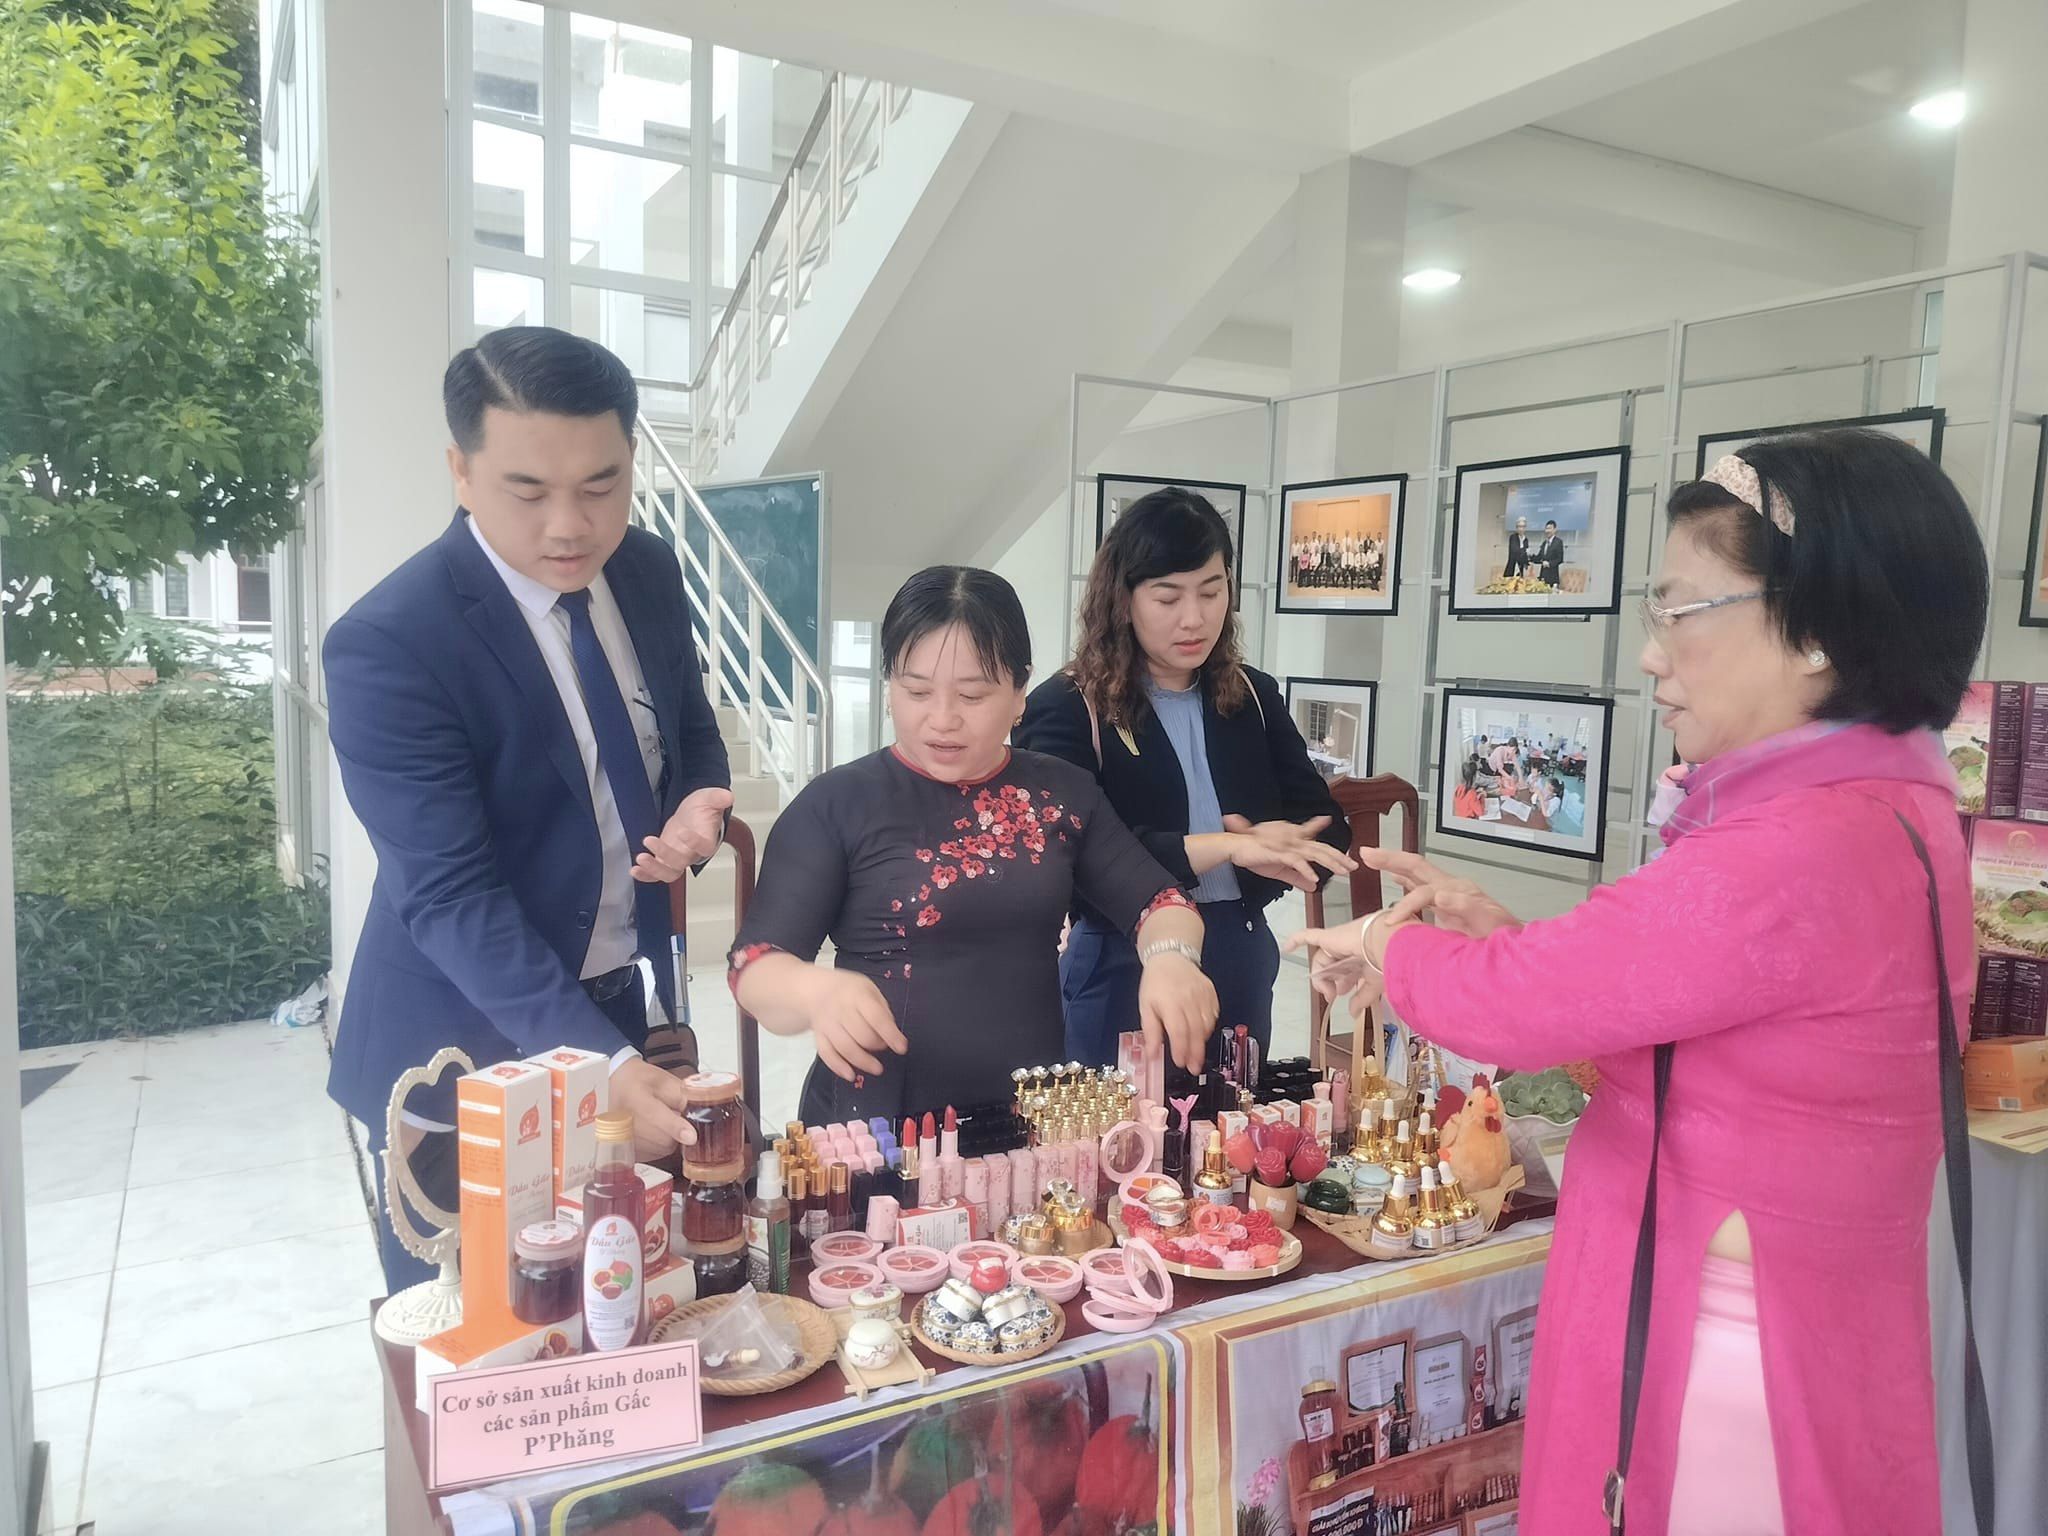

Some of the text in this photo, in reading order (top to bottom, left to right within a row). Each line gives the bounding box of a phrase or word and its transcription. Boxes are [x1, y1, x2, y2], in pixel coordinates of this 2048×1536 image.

[442, 1362, 688, 1414] Cơ sở sản xuất kinh doanh
[483, 1387, 651, 1433] các sản phẩm Gấc
